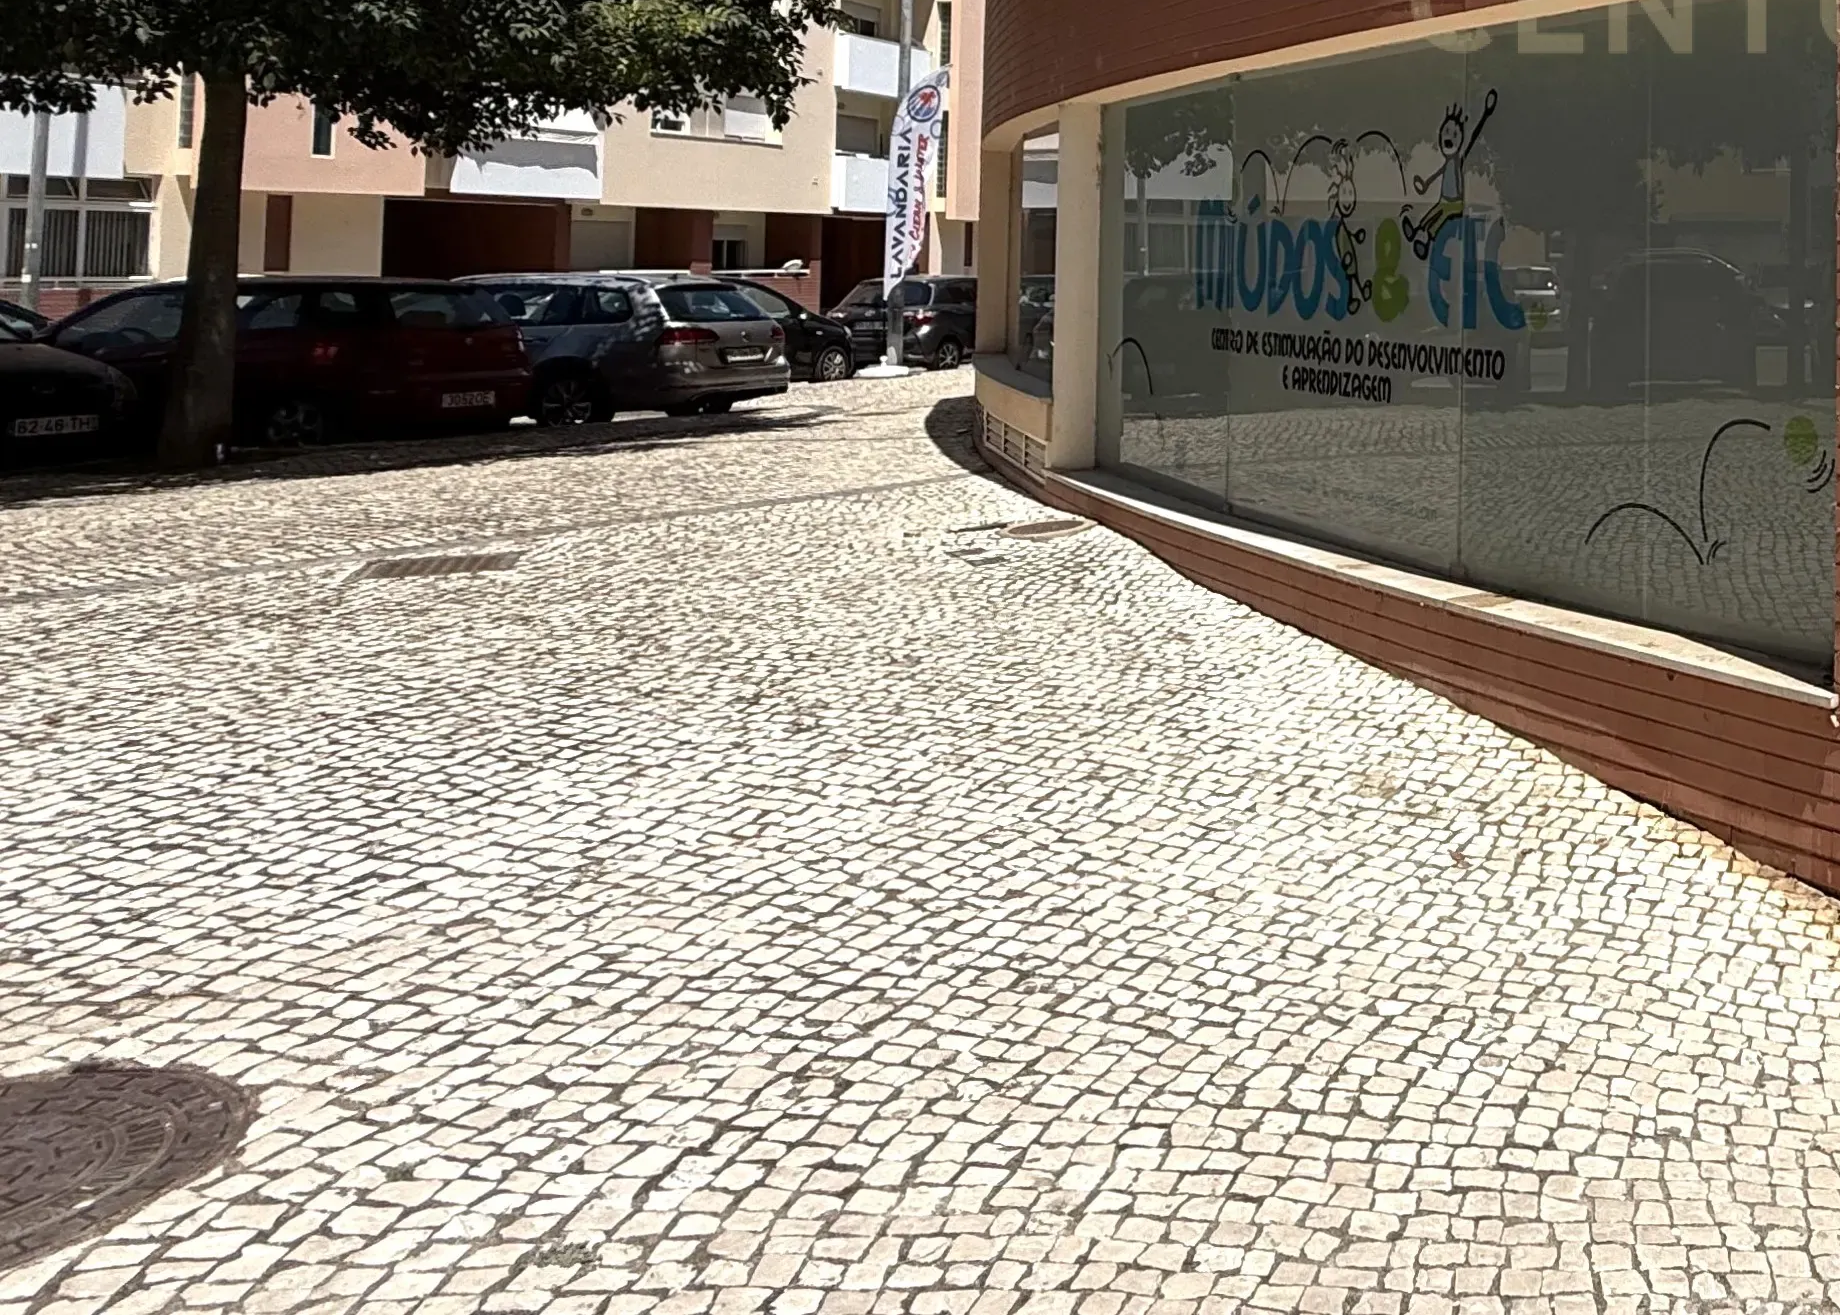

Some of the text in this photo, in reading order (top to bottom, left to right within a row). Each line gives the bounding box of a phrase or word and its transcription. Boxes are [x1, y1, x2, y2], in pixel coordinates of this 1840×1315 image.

[890, 126, 912, 279] LAVANDARIA
[1372, 217, 1411, 323] &
[1211, 327, 1505, 380] CENTRO DE ESTIMULAÇÃO DO DESENVOLVIMENTO
[1282, 364, 1392, 403] E APRENDIZAGEM
